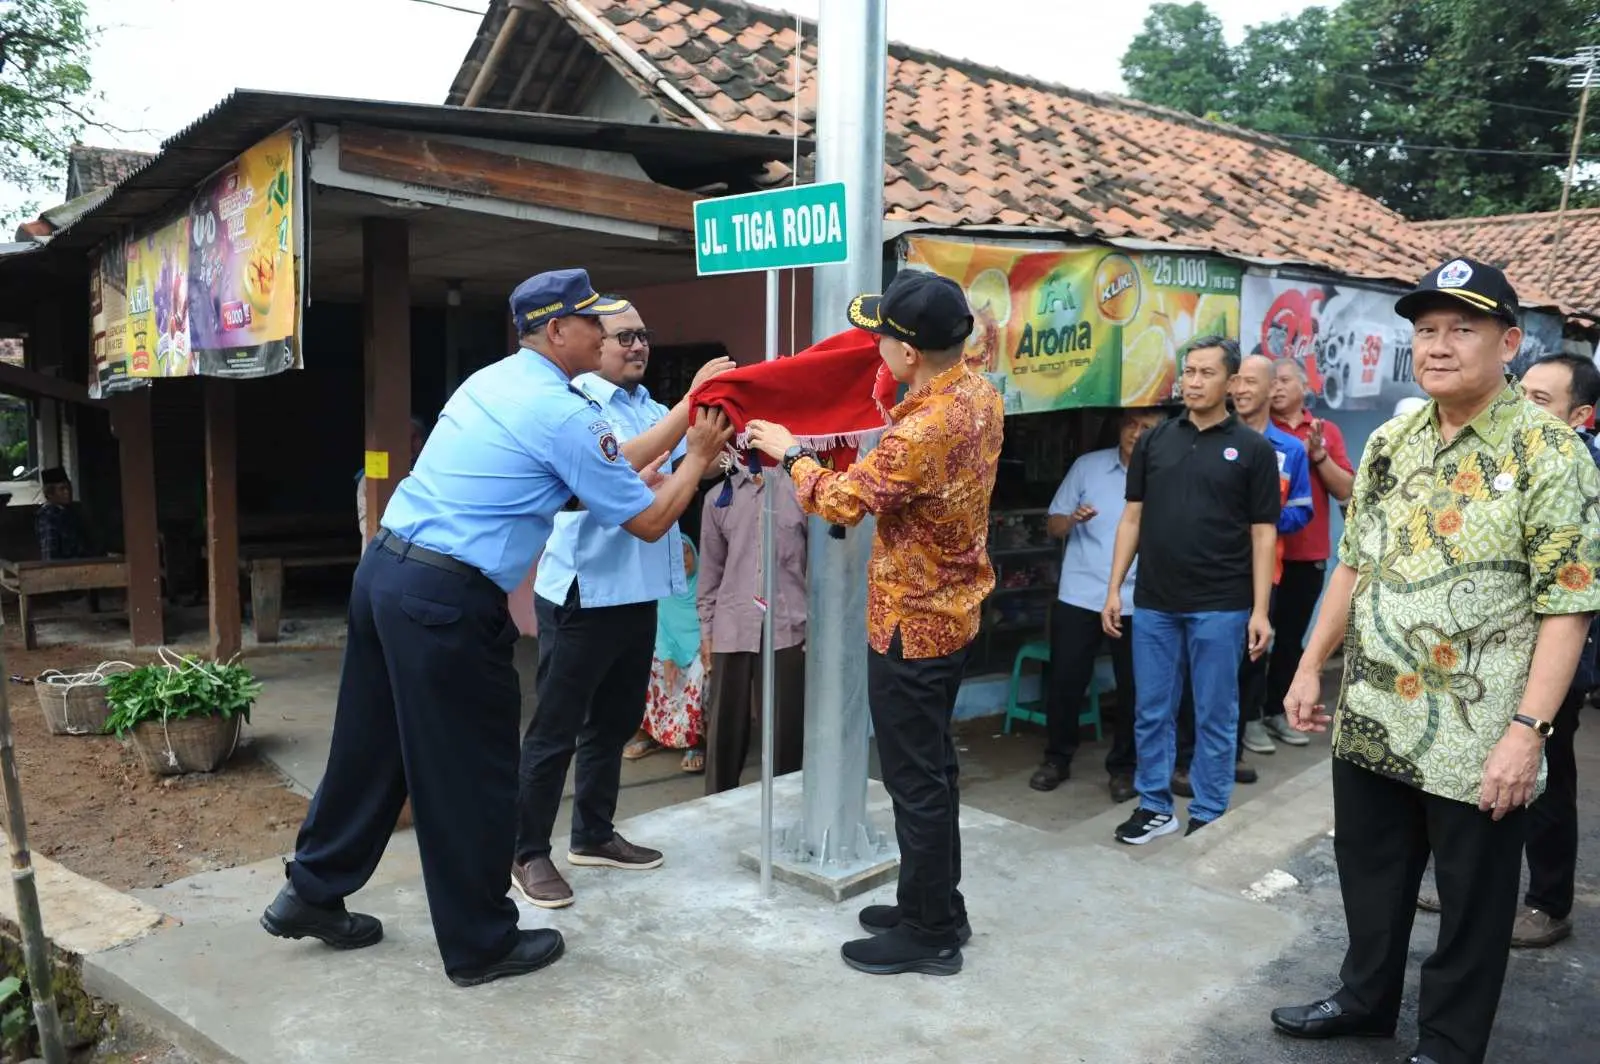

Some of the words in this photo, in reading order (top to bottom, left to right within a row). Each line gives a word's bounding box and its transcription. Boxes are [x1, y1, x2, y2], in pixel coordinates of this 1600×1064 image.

[701, 217, 728, 256] JL.
[731, 210, 777, 252] TIGA
[782, 202, 842, 247] RODA
[1153, 254, 1207, 287] 25.000
[1015, 321, 1092, 359] Aroma
